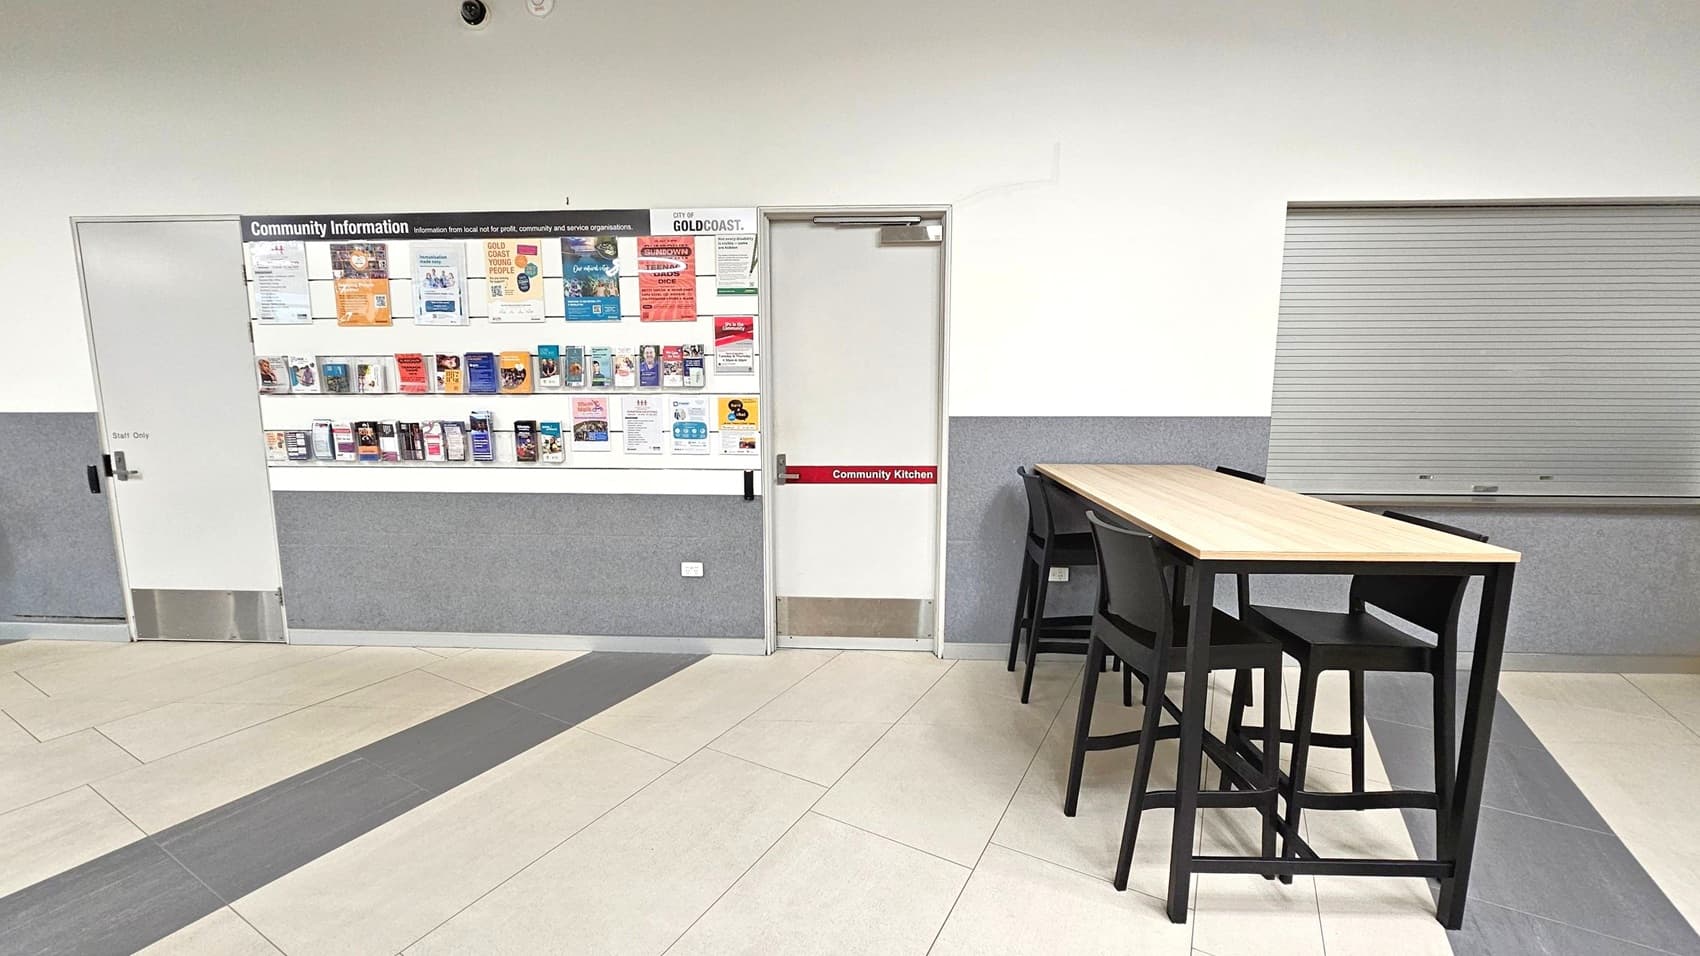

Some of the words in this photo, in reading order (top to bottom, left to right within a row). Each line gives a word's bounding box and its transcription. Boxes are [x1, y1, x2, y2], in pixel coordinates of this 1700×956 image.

[250, 220, 327, 238] Community
[330, 218, 409, 235] Information
[414, 226, 447, 234] Information
[500, 225, 518, 234] profit,
[519, 225, 552, 234] community
[590, 223, 633, 233] organisations.
[487, 242, 506, 250] GOLD
[487, 250, 510, 258] COAST
[133, 432, 150, 440] Only
[833, 470, 891, 480] Community
[894, 470, 933, 479] Kitchen
